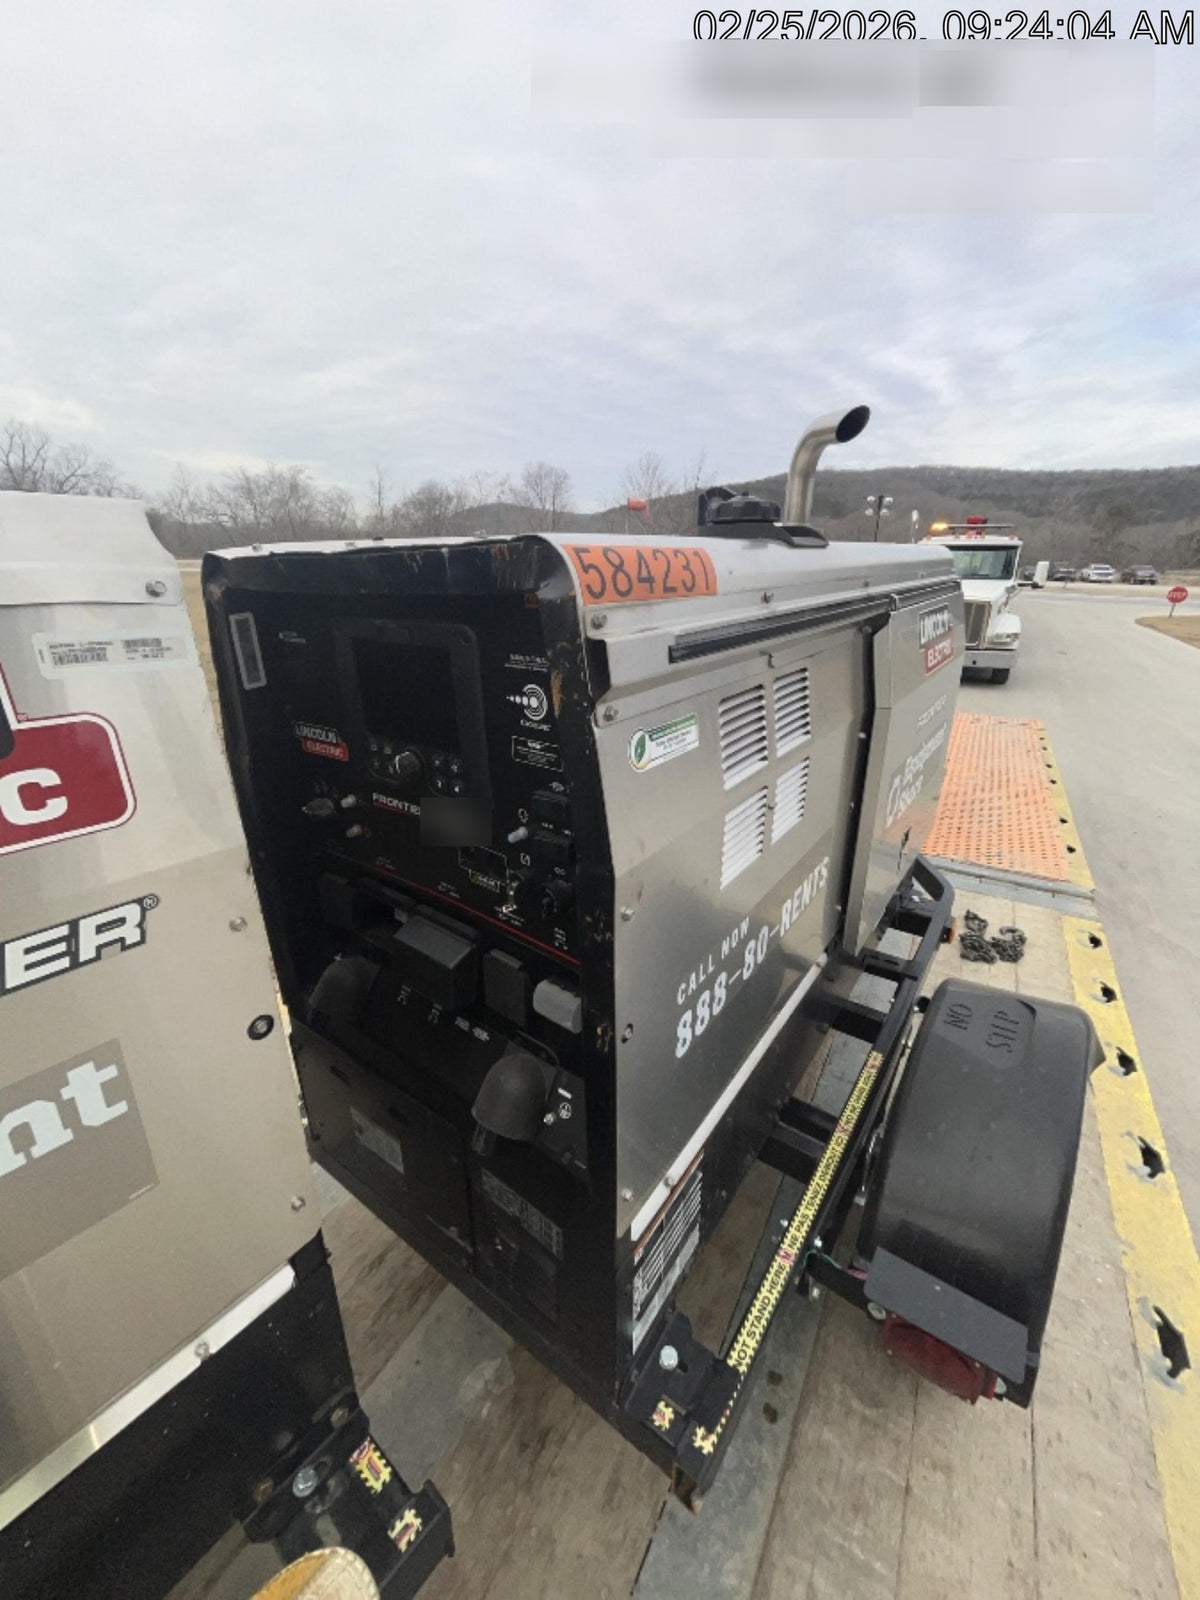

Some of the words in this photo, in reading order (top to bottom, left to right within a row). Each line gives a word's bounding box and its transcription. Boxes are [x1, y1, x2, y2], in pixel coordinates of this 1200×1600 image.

[572, 547, 711, 598] 584231
[0, 767, 69, 826] C
[372, 791, 422, 817] FRONTIE
[675, 856, 830, 1059] 888-80-RENTS
[676, 954, 715, 1005] CALL
[721, 915, 750, 960] NOW
[943, 1003, 974, 1031] NO
[734, 1340, 752, 1367] NOT
[746, 1295, 772, 1340] STAND
[766, 1263, 787, 1295] HERE
